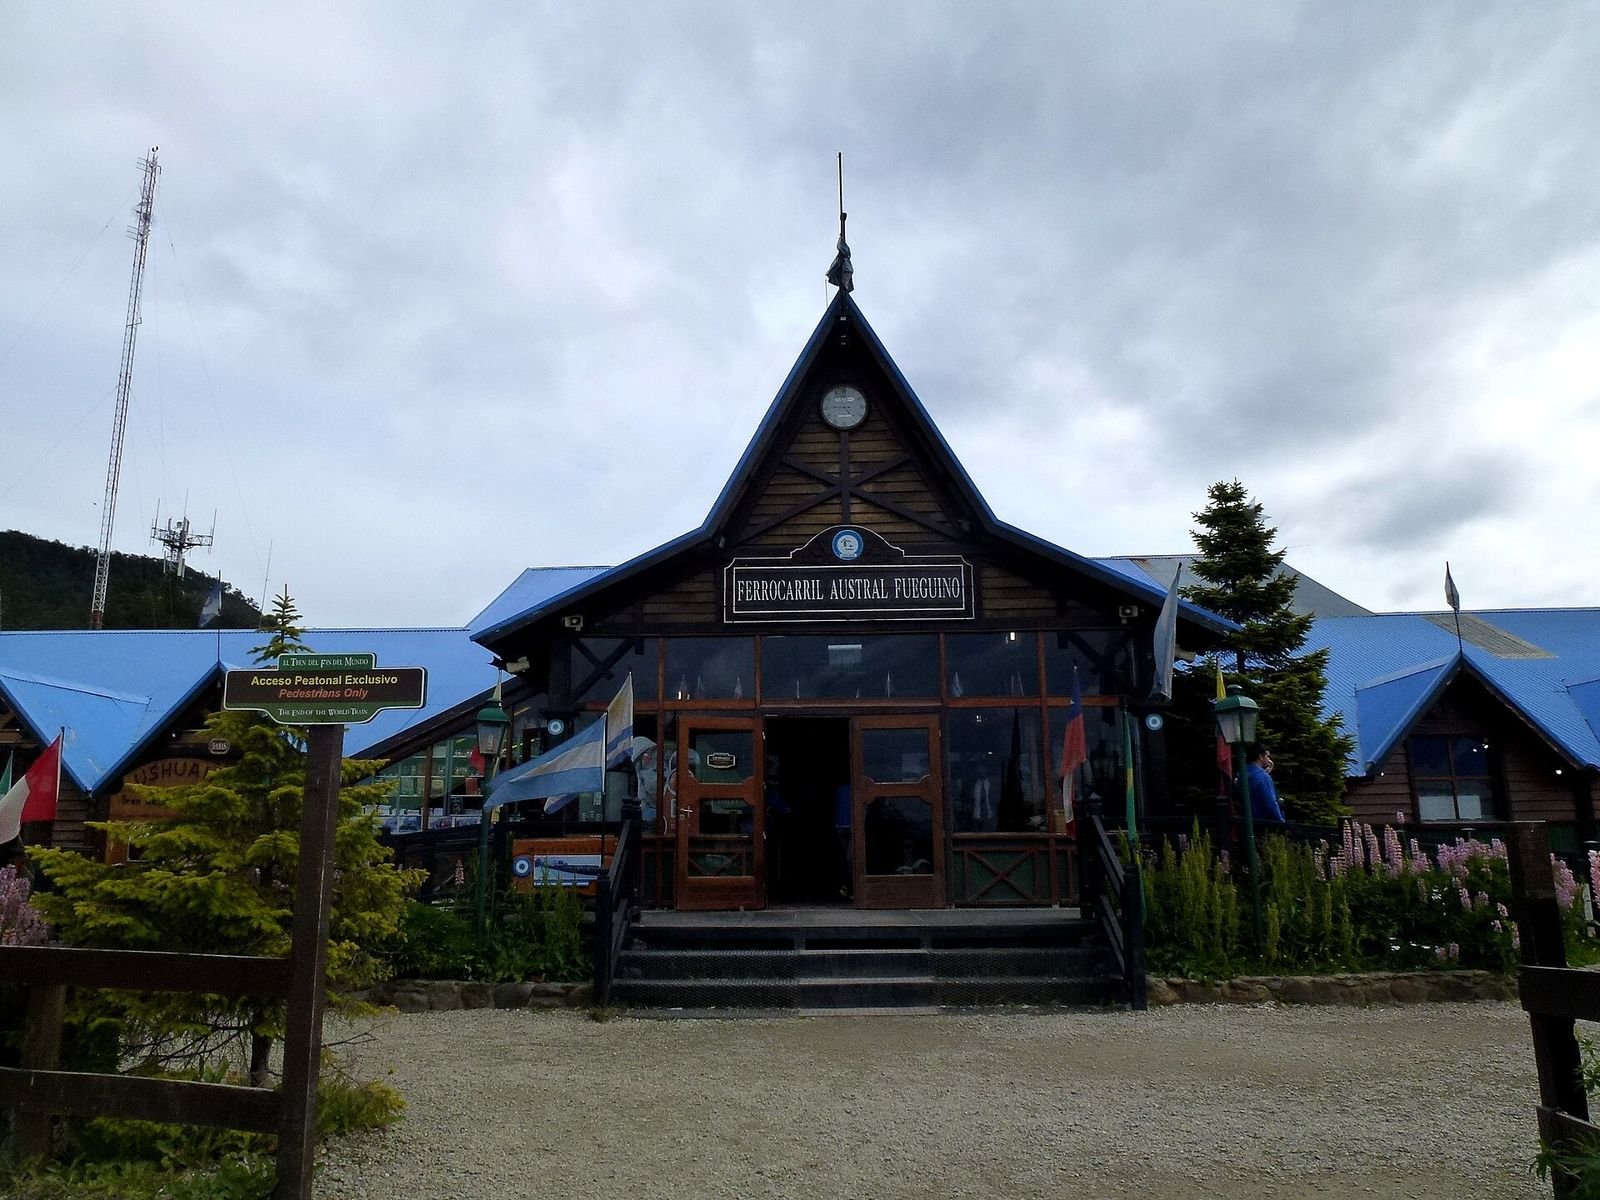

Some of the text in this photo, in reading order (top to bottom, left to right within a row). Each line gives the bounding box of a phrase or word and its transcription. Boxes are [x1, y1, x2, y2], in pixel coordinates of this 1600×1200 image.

[737, 577, 960, 601] FERROCARRIL AUSTRAL FUEGUINO
[344, 656, 369, 666] MUNDO
[251, 674, 398, 686] Acceso Peatonal Exclusivo
[278, 687, 369, 699] Pedestrians Only
[278, 708, 290, 716] THE
[291, 709, 305, 717] END
[328, 708, 350, 716] WORLD
[134, 761, 211, 785] USHUAI
